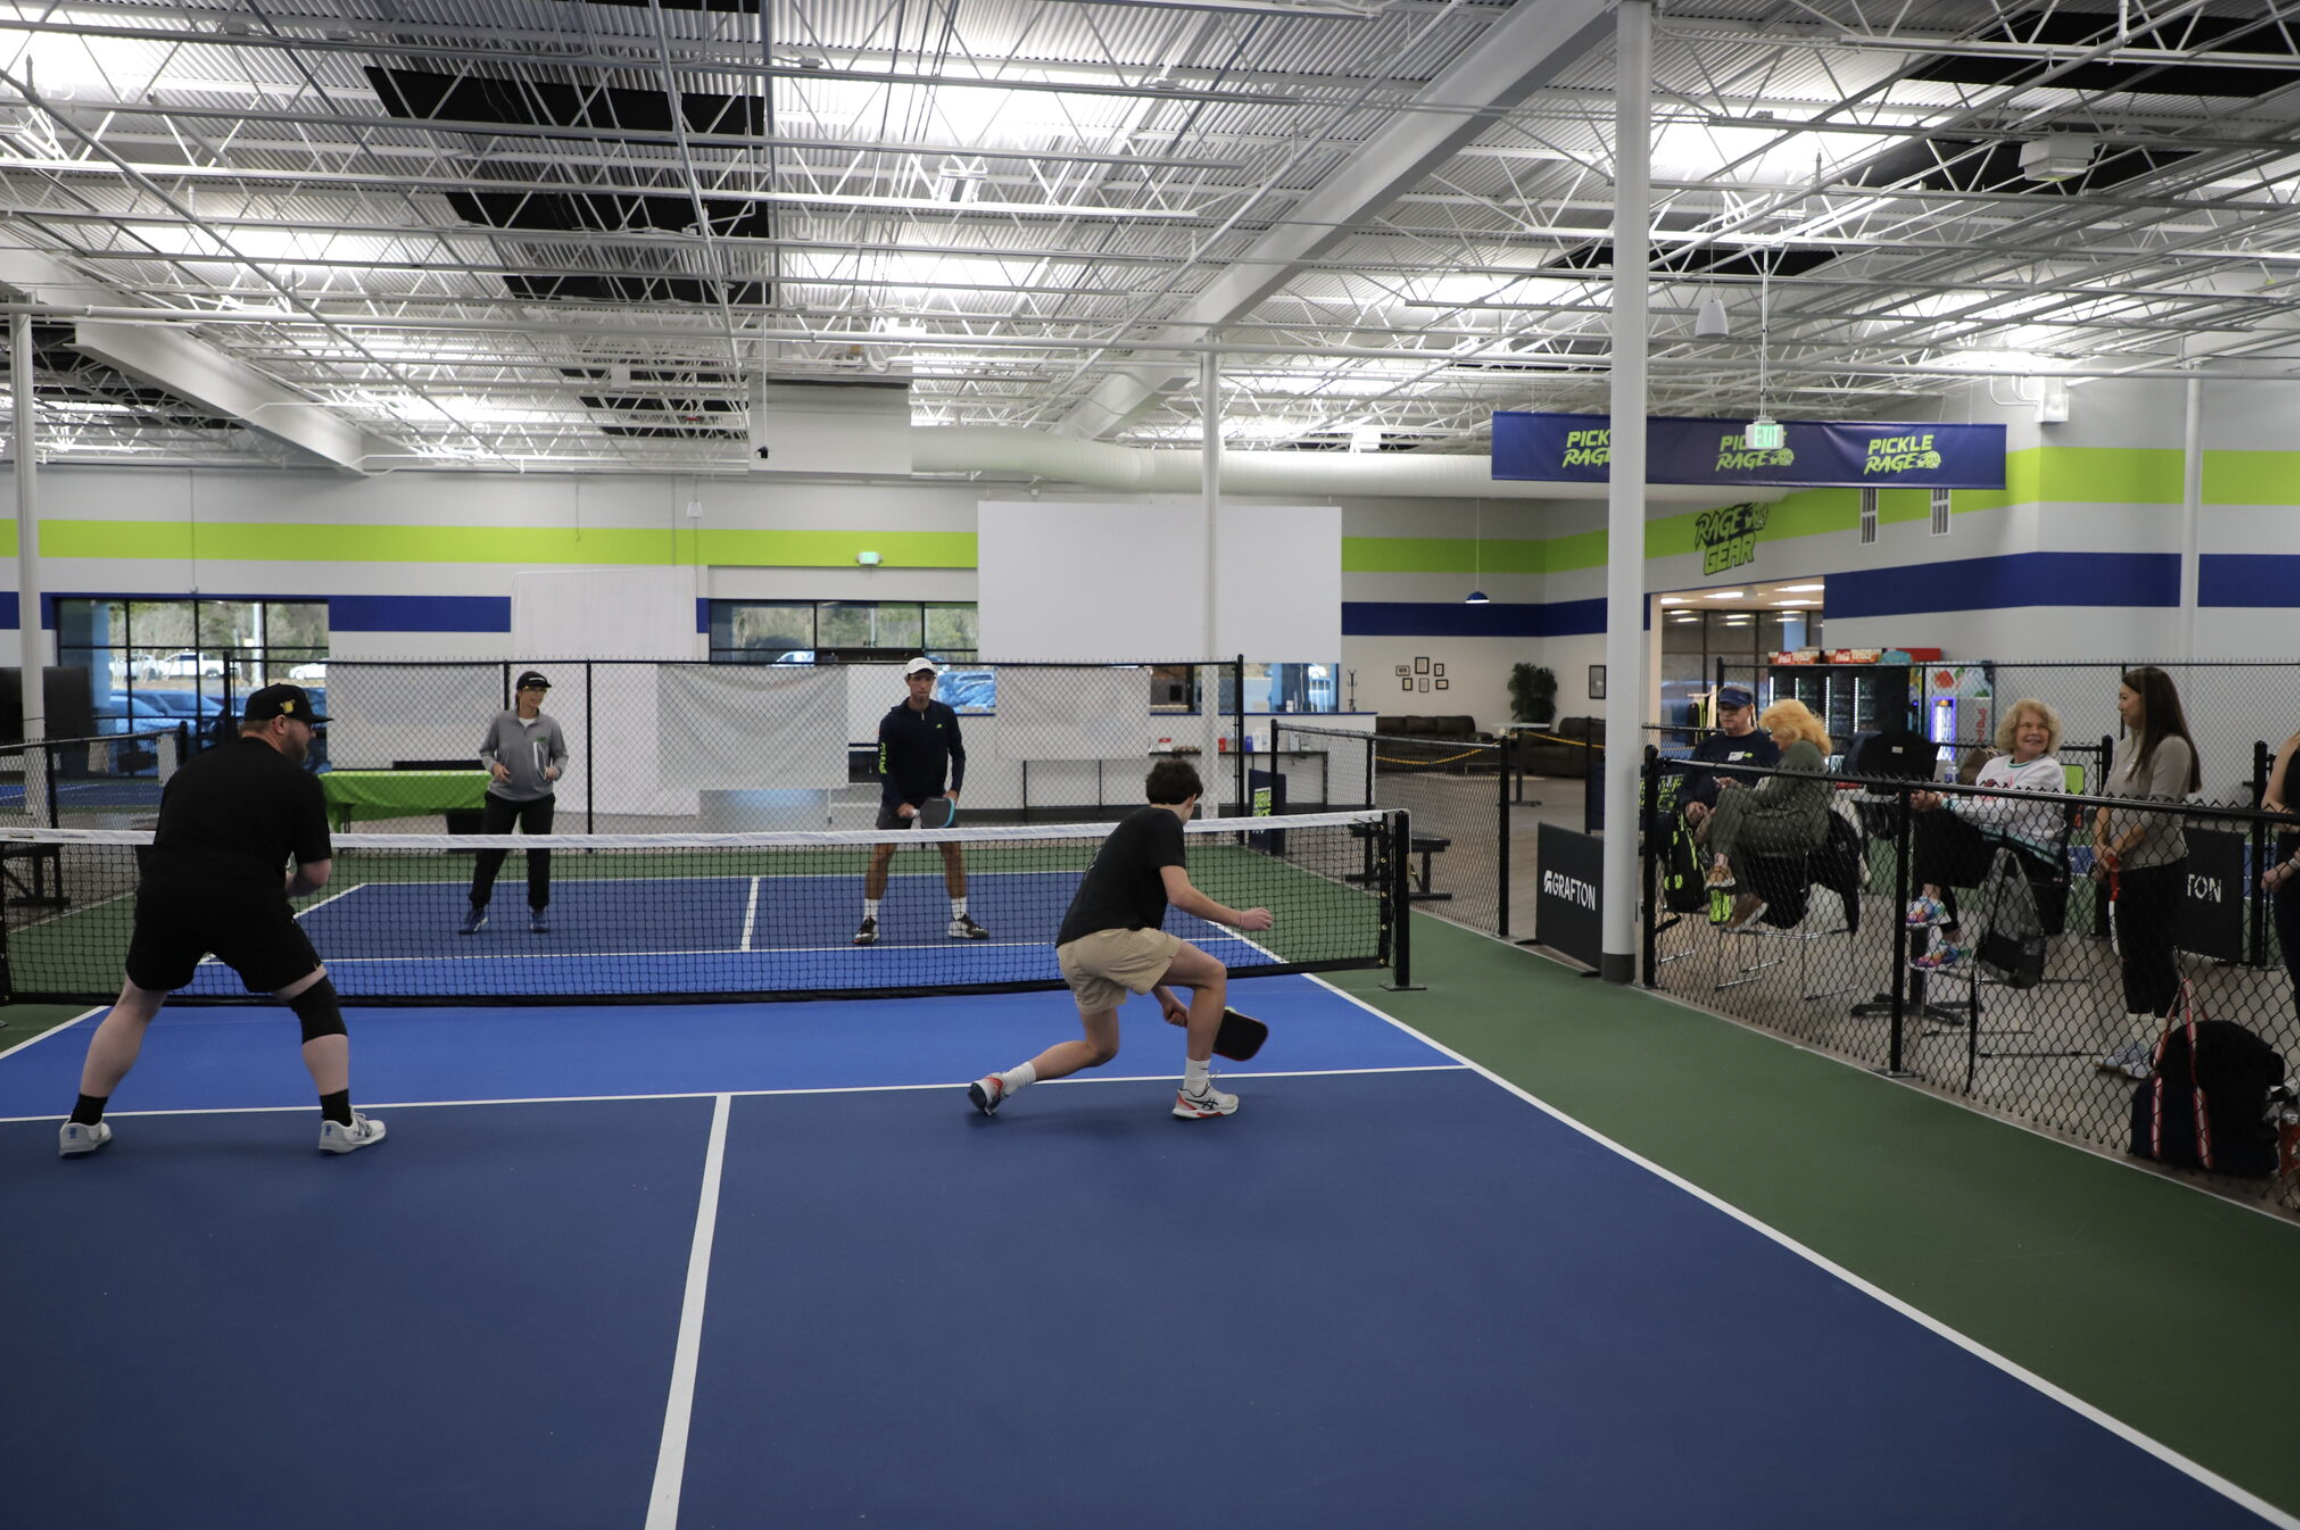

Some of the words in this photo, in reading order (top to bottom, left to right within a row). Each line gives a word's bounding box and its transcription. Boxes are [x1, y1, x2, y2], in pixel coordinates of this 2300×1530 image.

[1566, 429, 1611, 448] PICK
[1867, 434, 1934, 455] PICKLE
[1715, 450, 1769, 472] RAGE
[1863, 452, 1920, 475] RAGE
[1694, 503, 1750, 551] RAGE
[1703, 532, 1756, 576] GEAR
[1552, 872, 1596, 911] GRAFTON
